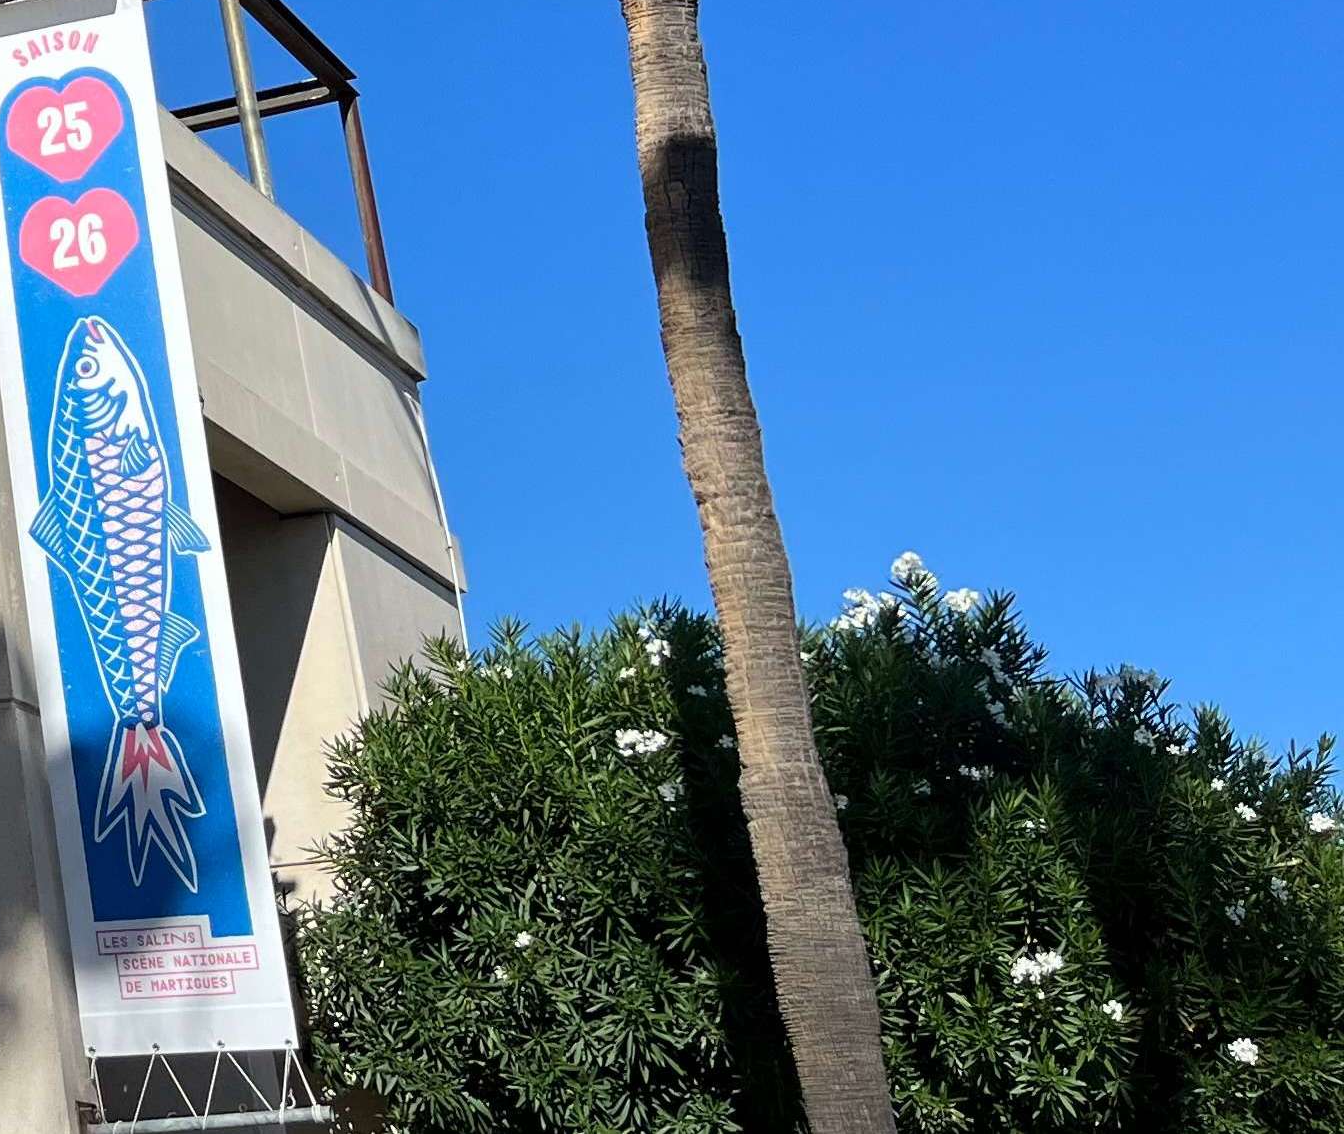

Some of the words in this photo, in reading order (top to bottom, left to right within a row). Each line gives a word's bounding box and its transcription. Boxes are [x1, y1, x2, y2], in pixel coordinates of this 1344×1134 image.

[12, 30, 99, 67] SAISON
[36, 101, 93, 156] 25
[49, 213, 107, 270] 26
[103, 935, 128, 949] LES
[137, 931, 196, 947] SALINS
[174, 951, 251, 968] NATIONALE
[126, 979, 143, 993] DE
[151, 976, 228, 992] MARTIGUES
